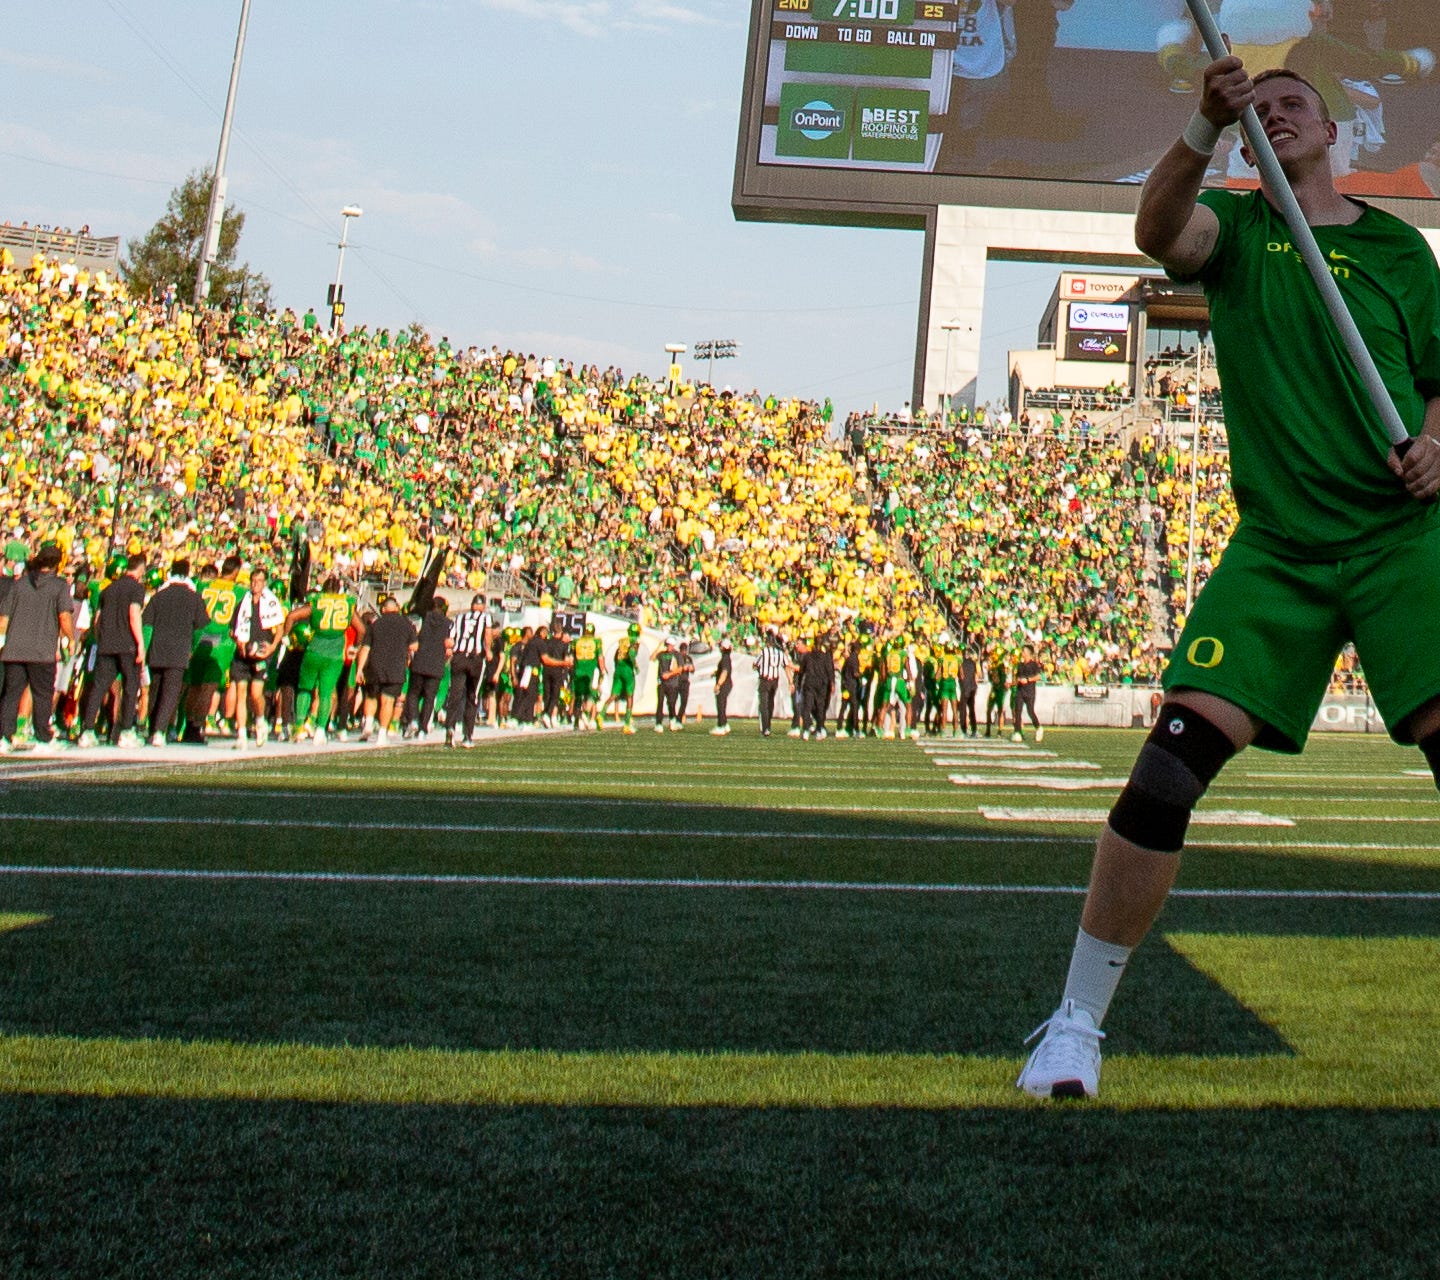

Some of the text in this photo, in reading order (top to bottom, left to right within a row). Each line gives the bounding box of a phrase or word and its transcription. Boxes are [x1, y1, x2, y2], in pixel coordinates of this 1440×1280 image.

[923, 5, 944, 18] 25
[785, 24, 819, 40] DOWN
[837, 27, 872, 43] TO GO
[886, 30, 936, 47] BALL ON
[794, 112, 841, 128] OnPoint
[873, 107, 921, 124] BEST
[861, 122, 908, 134] ROOFING
[1089, 283, 1125, 292] TOYOTA
[201, 588, 237, 625] 73
[316, 597, 350, 631] 72
[1186, 636, 1225, 669] O
